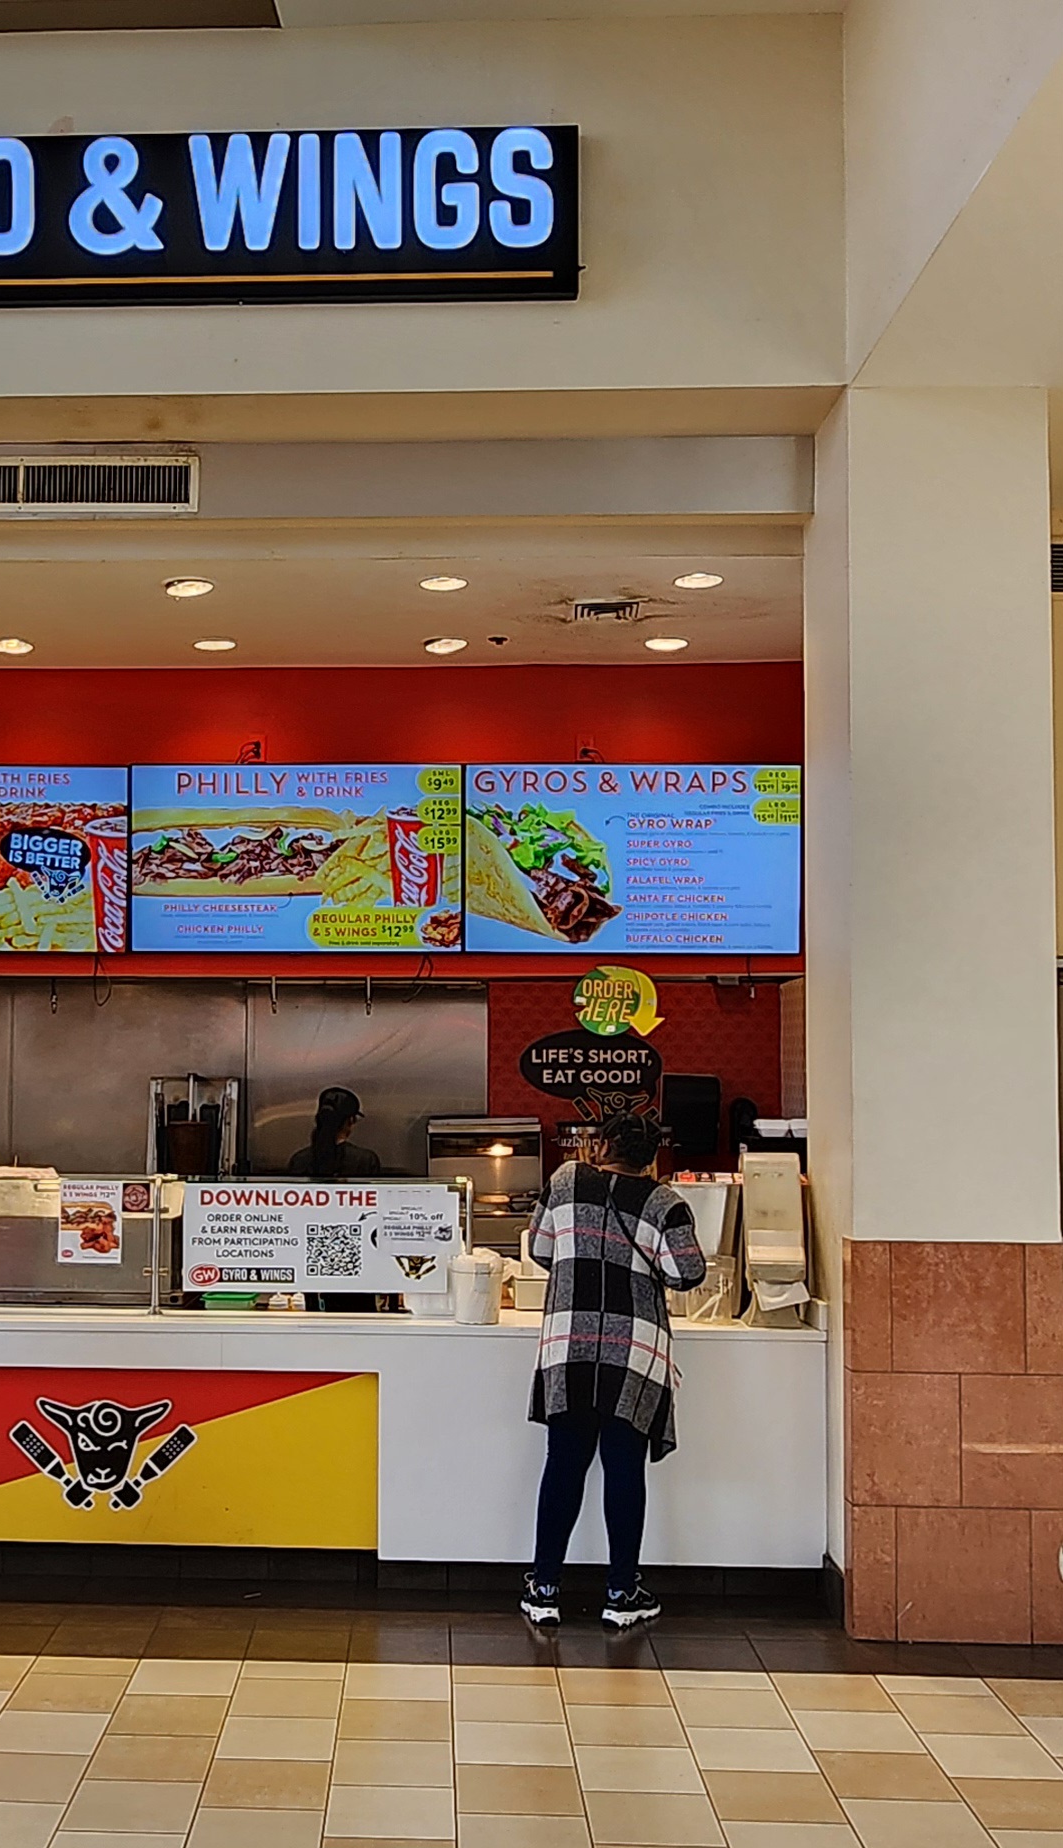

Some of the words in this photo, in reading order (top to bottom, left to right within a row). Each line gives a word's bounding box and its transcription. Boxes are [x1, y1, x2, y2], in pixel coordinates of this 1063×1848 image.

[67, 136, 164, 256] &
[188, 127, 555, 253] WINGS
[28, 773, 72, 785] FRIES
[296, 771, 338, 783] WITH
[344, 771, 389, 783] FRIES
[473, 769, 588, 794] GYROS
[598, 770, 619, 794] &
[630, 770, 749, 794] WRAPS
[176, 771, 289, 796] PHILLY
[296, 785, 307, 798] &
[314, 785, 364, 798] DRINK
[626, 819, 667, 829] GYRO
[9, 833, 83, 857] BIGGER
[626, 840, 660, 848] SUPER
[662, 840, 692, 848] GYRO
[8, 850, 23, 863] IS
[25, 852, 81, 870] BETTER
[626, 858, 657, 866] SPICY
[659, 858, 690, 866] GYRO
[626, 894, 659, 903] SANTA
[677, 895, 725, 903] CHICKEN
[163, 904, 201, 912] PHILLY
[203, 904, 278, 912] CHEESESTEAK
[312, 913, 370, 924] REGULAR
[374, 913, 418, 924] PHILLY
[626, 912, 678, 921] CHIPOTLE
[681, 913, 728, 921] CHICKEN
[176, 924, 225, 934] CHICKEN
[227, 924, 265, 934] PHILLY
[312, 927, 323, 937] &
[324, 927, 332, 937] 5
[335, 927, 377, 937] WINGS
[626, 934, 673, 943] BUFFALO
[676, 934, 724, 943] CHICKEN
[582, 978, 635, 999] ORDER
[580, 998, 635, 1023] HERE
[531, 1047, 584, 1064] LIFE'S
[587, 1050, 653, 1067] SHORT,
[542, 1069, 576, 1084] EAT
[580, 1069, 642, 1084] GOOD!
[199, 1189, 330, 1207] DOWNLOAD
[335, 1189, 378, 1207] THE
[205, 1212, 243, 1223] ORDER
[244, 1213, 285, 1223] ONLINE
[409, 1213, 428, 1221] 10%
[430, 1213, 444, 1221] off
[199, 1225, 208, 1235] &
[210, 1225, 238, 1235] EARN
[239, 1225, 290, 1235] REWARDS
[191, 1236, 222, 1247] FROM
[223, 1237, 299, 1247] PARTICIPATING
[214, 1248, 275, 1259] LOCATIONS
[191, 1269, 218, 1284] GW
[221, 1268, 248, 1282] GYRO
[249, 1269, 258, 1282] &
[260, 1268, 293, 1283] WINGS
